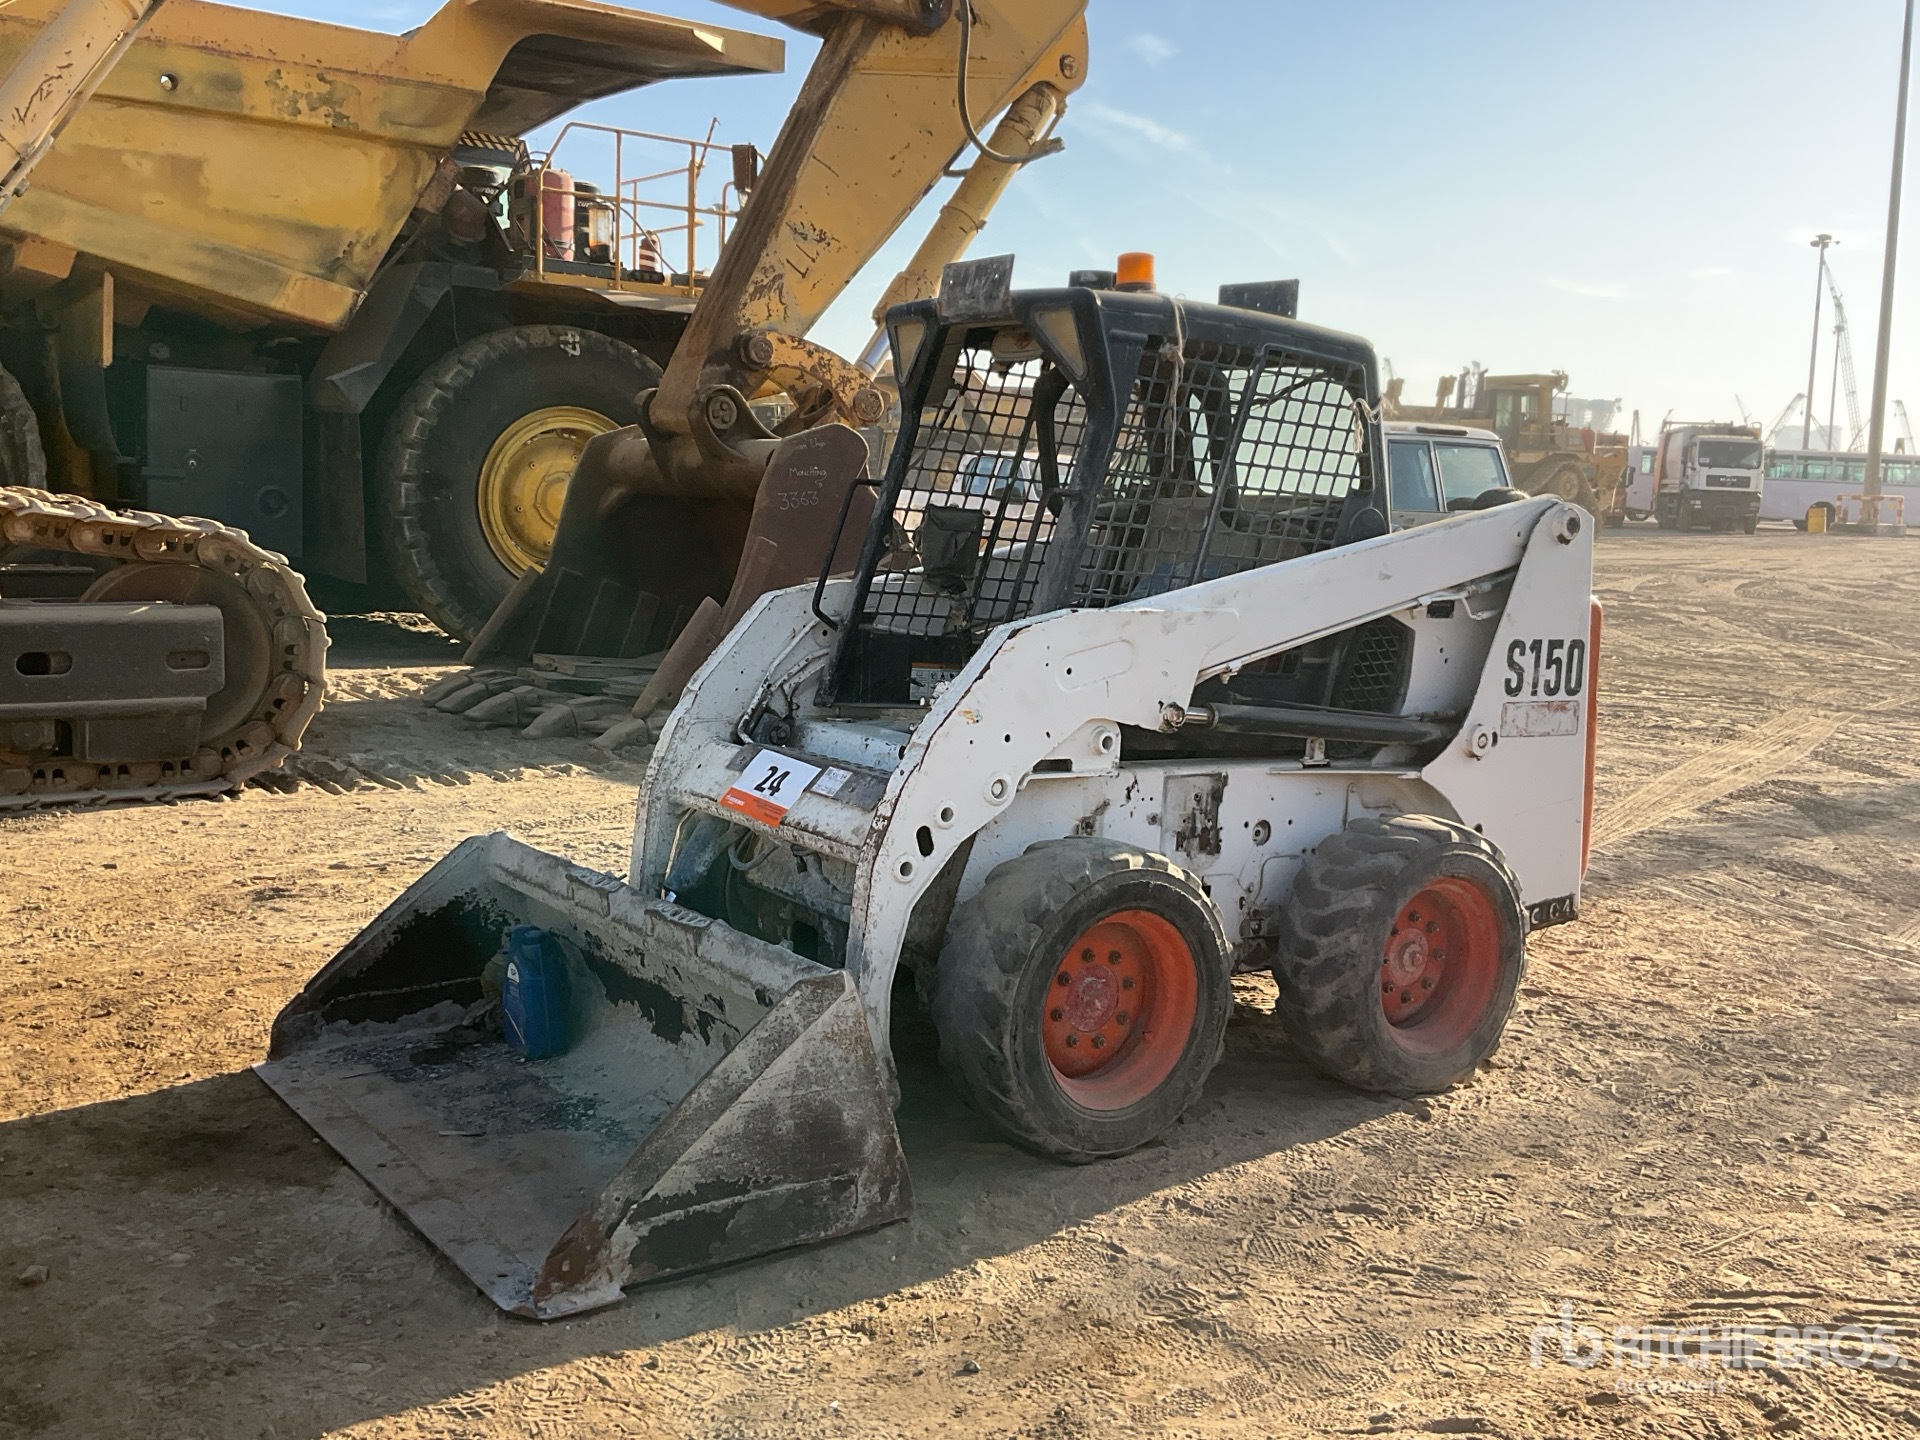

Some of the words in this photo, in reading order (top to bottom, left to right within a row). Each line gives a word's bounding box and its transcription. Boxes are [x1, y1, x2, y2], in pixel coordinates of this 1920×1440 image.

[778, 491, 819, 510] 3363
[1505, 639, 1585, 697] S150
[753, 766, 791, 796] 24
